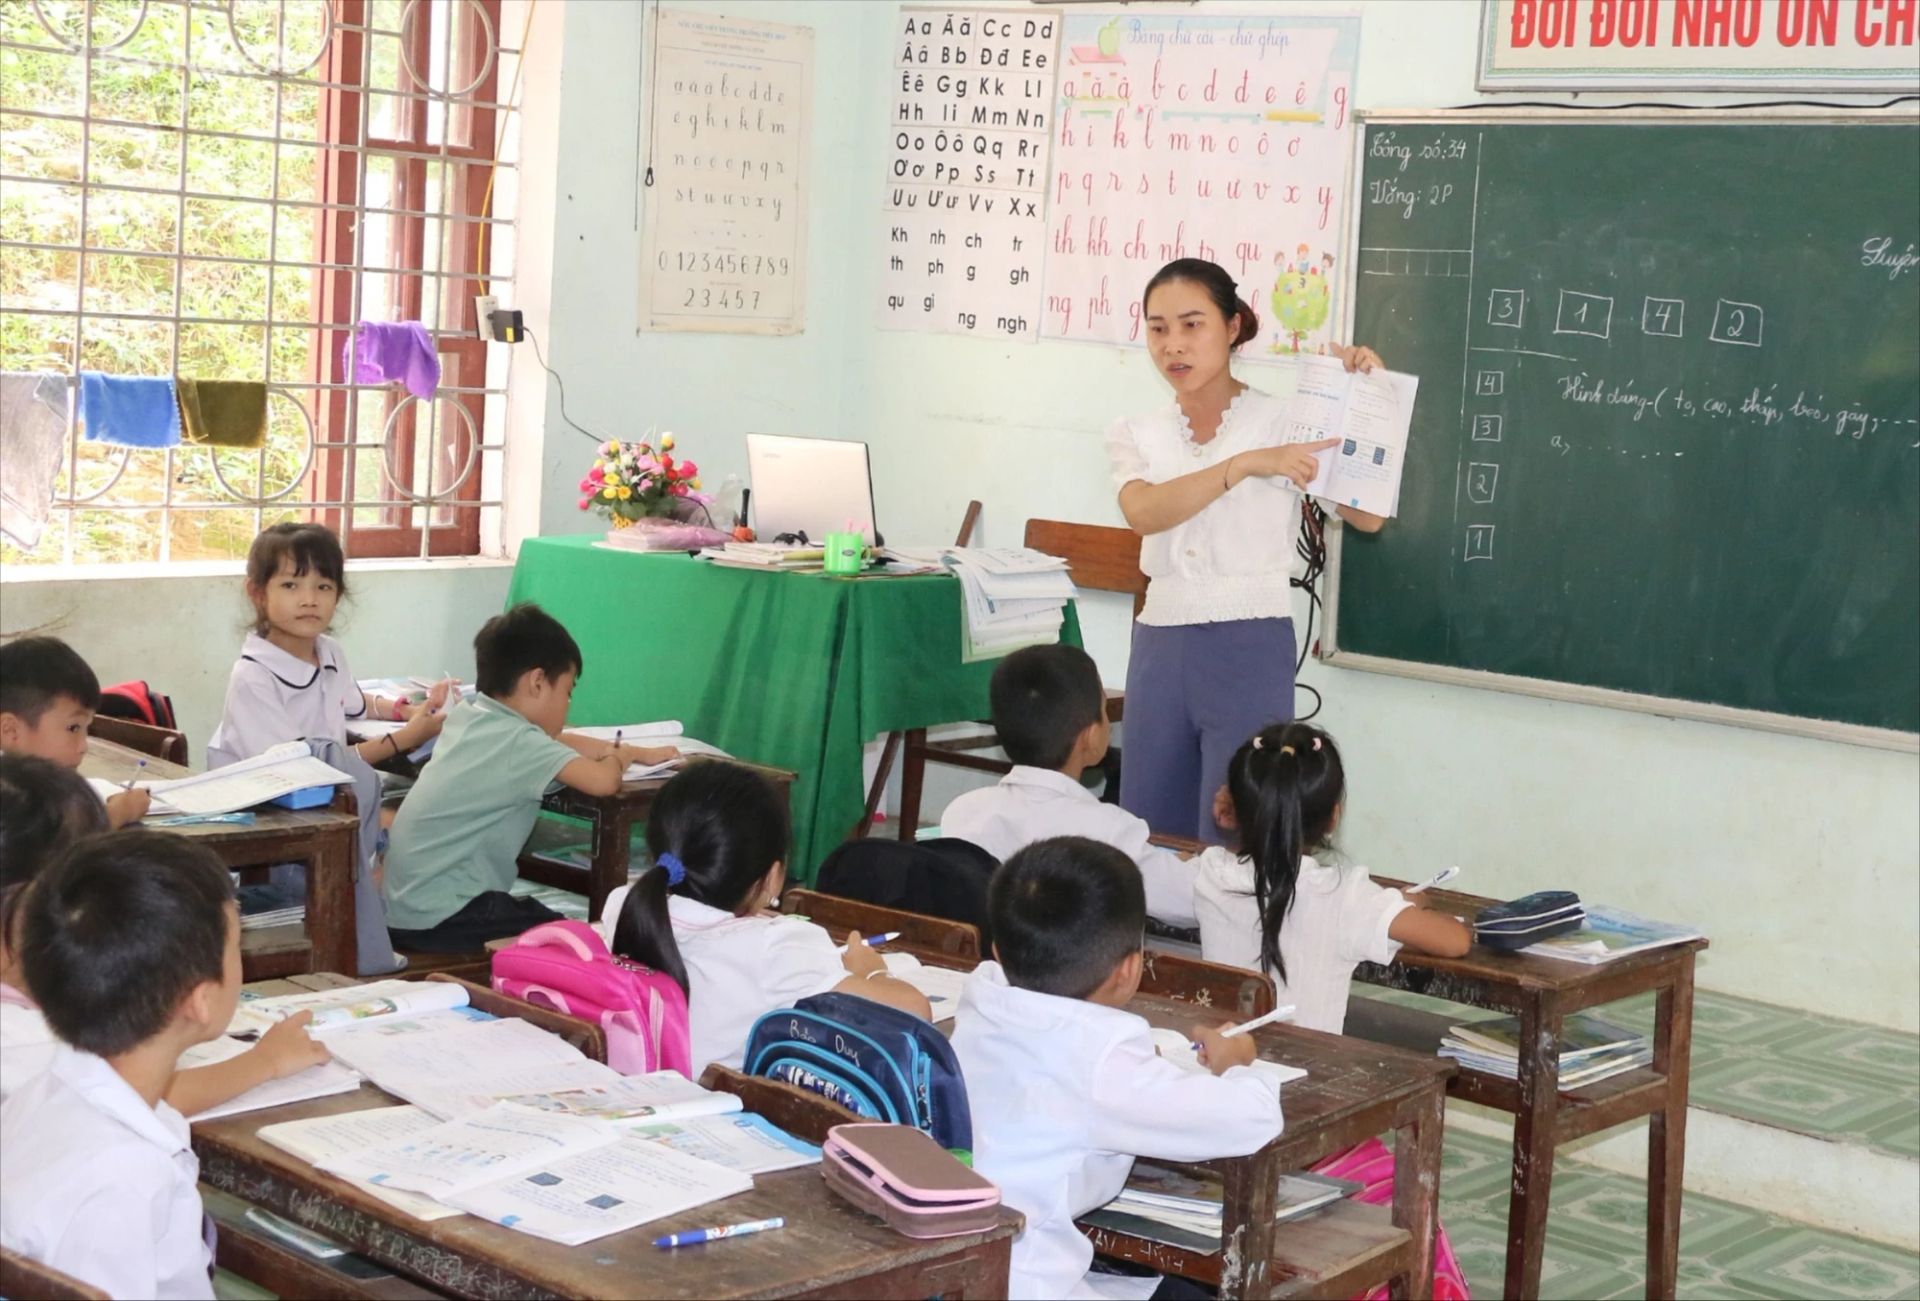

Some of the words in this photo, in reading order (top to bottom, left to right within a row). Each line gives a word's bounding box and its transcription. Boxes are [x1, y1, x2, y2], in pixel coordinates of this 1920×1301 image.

[1855, 0, 1919, 47] CH
[1063, 81, 1077, 98] a
[1152, 59, 1166, 100] b
[1178, 83, 1188, 101] c
[1203, 68, 1218, 102] d
[1265, 86, 1276, 104] e
[1334, 86, 1347, 130] g
[1061, 107, 1075, 147] h
[1087, 124, 1094, 147] i
[1113, 107, 1129, 149] k
[1168, 132, 1191, 151] m
[1199, 134, 1216, 153] n
[1228, 135, 1239, 154] o
[1057, 171, 1072, 205] p
[1082, 172, 1092, 206] q
[1106, 171, 1122, 192] r
[1137, 173, 1149, 194] s
[1168, 169, 1177, 196] t
[1198, 180, 1212, 198] u
[1253, 182, 1271, 200] v
[1282, 185, 1301, 204] x
[1318, 186, 1333, 230] y
[891, 227, 908, 243] Kh
[929, 229, 946, 245] nh
[965, 232, 982, 249] ch
[1012, 235, 1023, 252] tr
[1055, 214, 1076, 254] th
[1088, 215, 1112, 257] kh
[1123, 219, 1149, 260] ch
[1160, 220, 1186, 261] nh
[1235, 242, 1261, 277] qu
[890, 255, 904, 271] th
[928, 258, 944, 277] ph
[967, 265, 976, 281] g
[1010, 266, 1030, 285] gh
[888, 295, 905, 310] qu
[923, 292, 935, 312] gi
[958, 312, 976, 330] ng
[997, 315, 1027, 334] ngh
[1048, 295, 1071, 335] ng
[1088, 274, 1112, 330] ph
[1498, 298, 1513, 319] 3
[1574, 302, 1588, 323] 1
[1656, 304, 1671, 331] 4
[1727, 310, 1745, 337] 2
[835, 1034, 860, 1067] Duy
